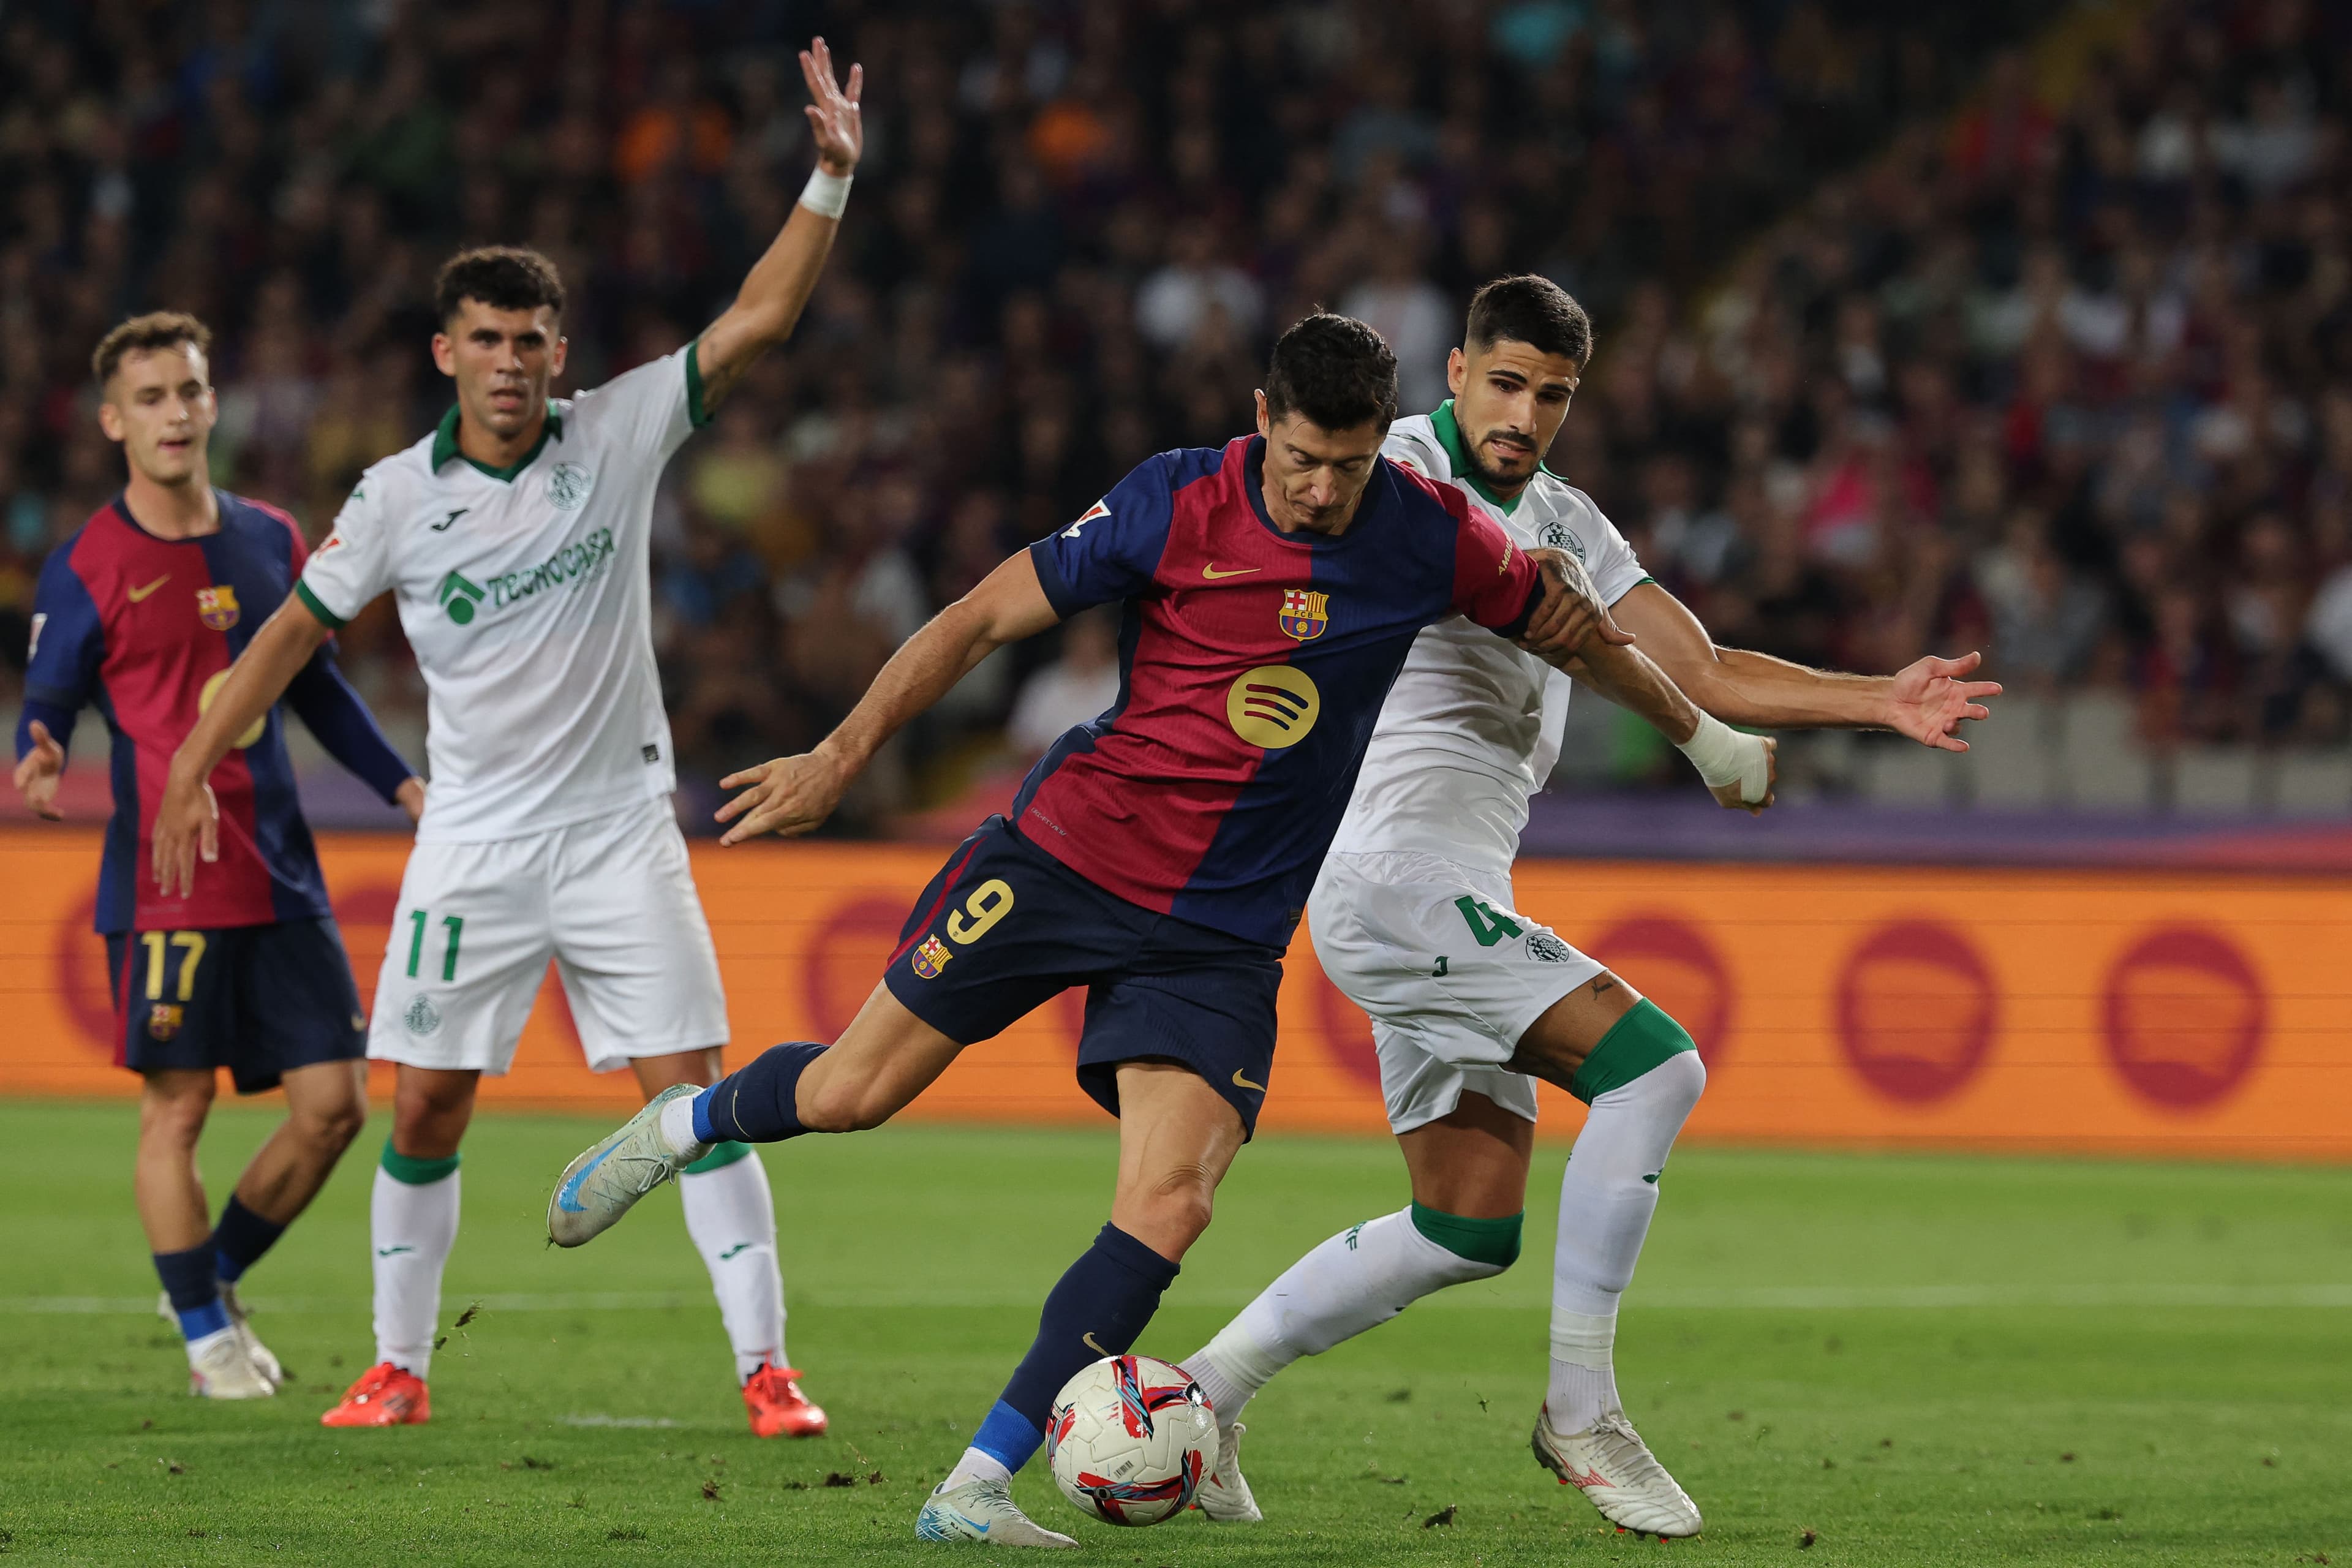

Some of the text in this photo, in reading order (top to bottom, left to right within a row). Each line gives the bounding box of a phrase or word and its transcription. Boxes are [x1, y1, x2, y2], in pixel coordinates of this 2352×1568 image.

[947, 879, 1014, 944] 9
[1454, 895, 1525, 947] 4
[140, 930, 206, 1001] 17
[407, 910, 463, 982] 11
